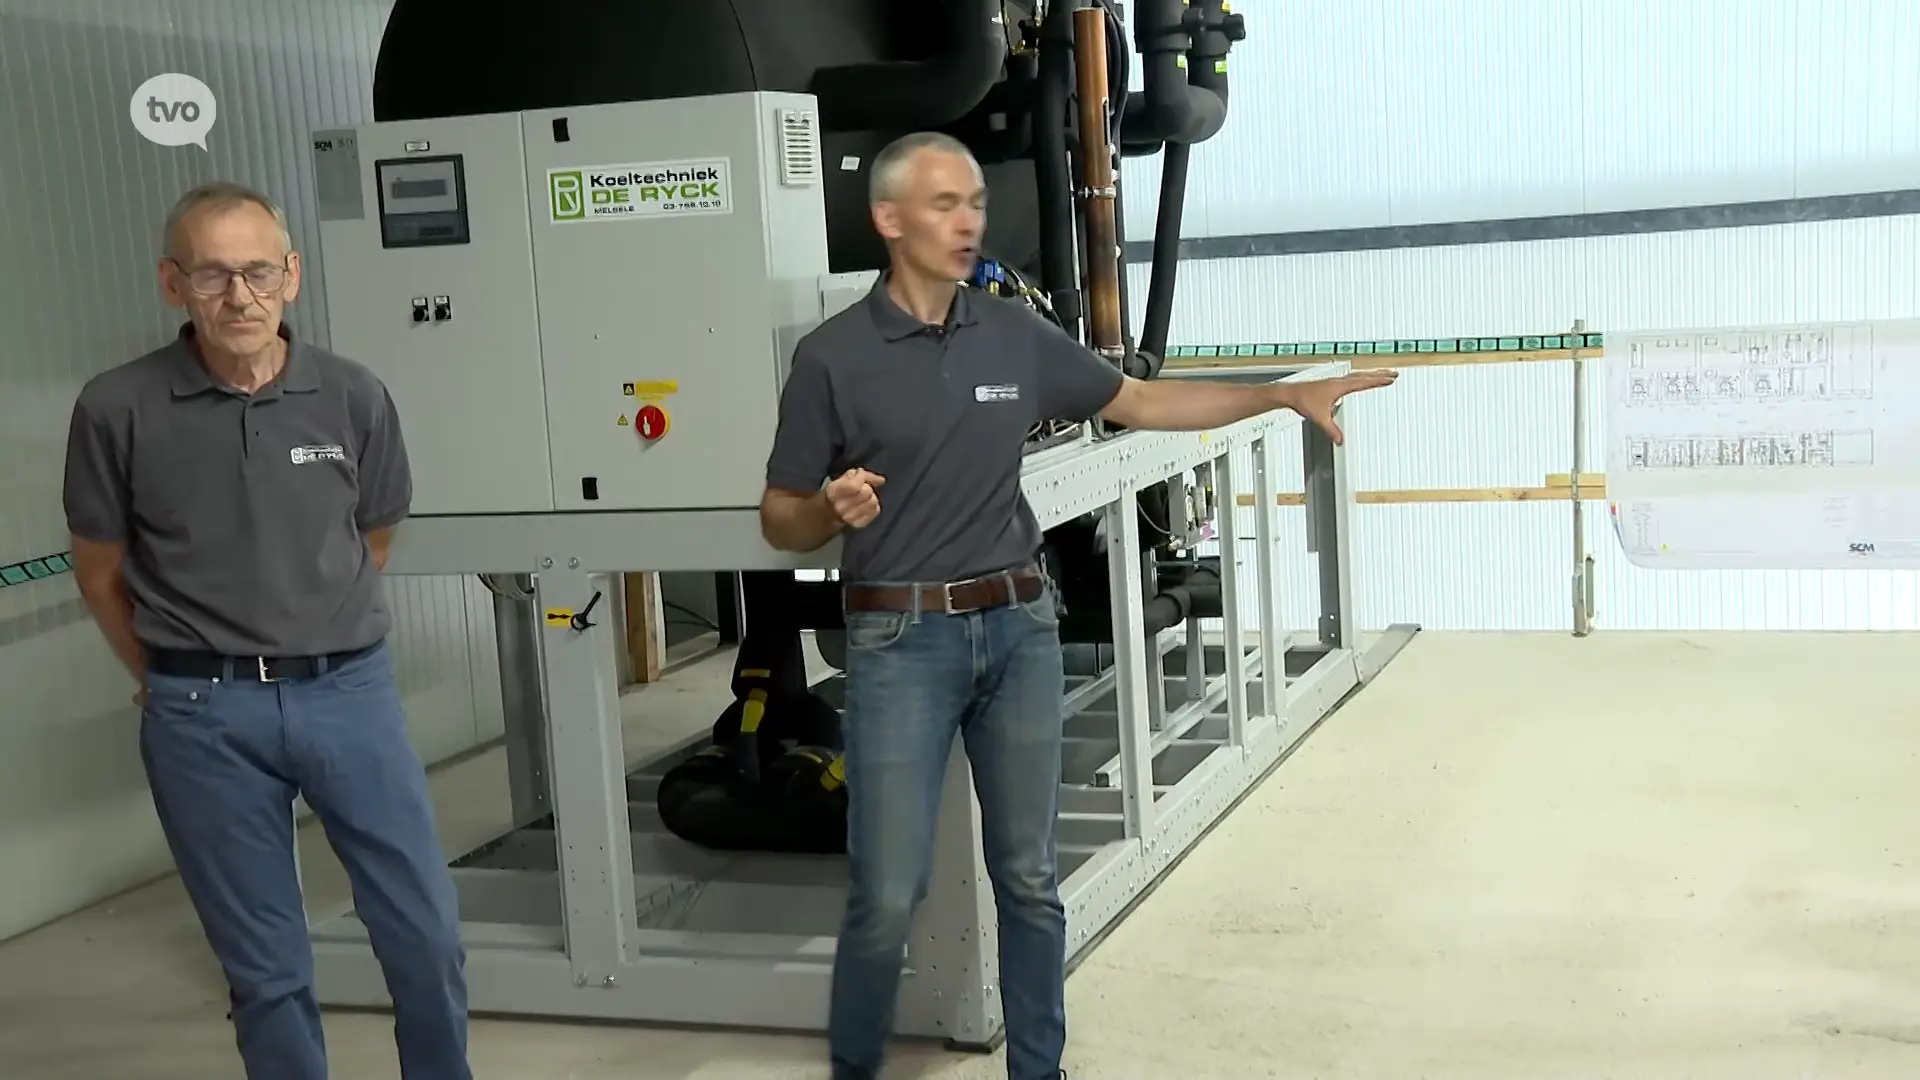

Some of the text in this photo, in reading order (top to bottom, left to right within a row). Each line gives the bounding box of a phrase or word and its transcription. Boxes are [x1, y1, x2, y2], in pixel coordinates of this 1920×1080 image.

[590, 167, 719, 188] Koeltechniek
[592, 182, 720, 204] DE RYCK
[1848, 543, 1876, 553] SCM
